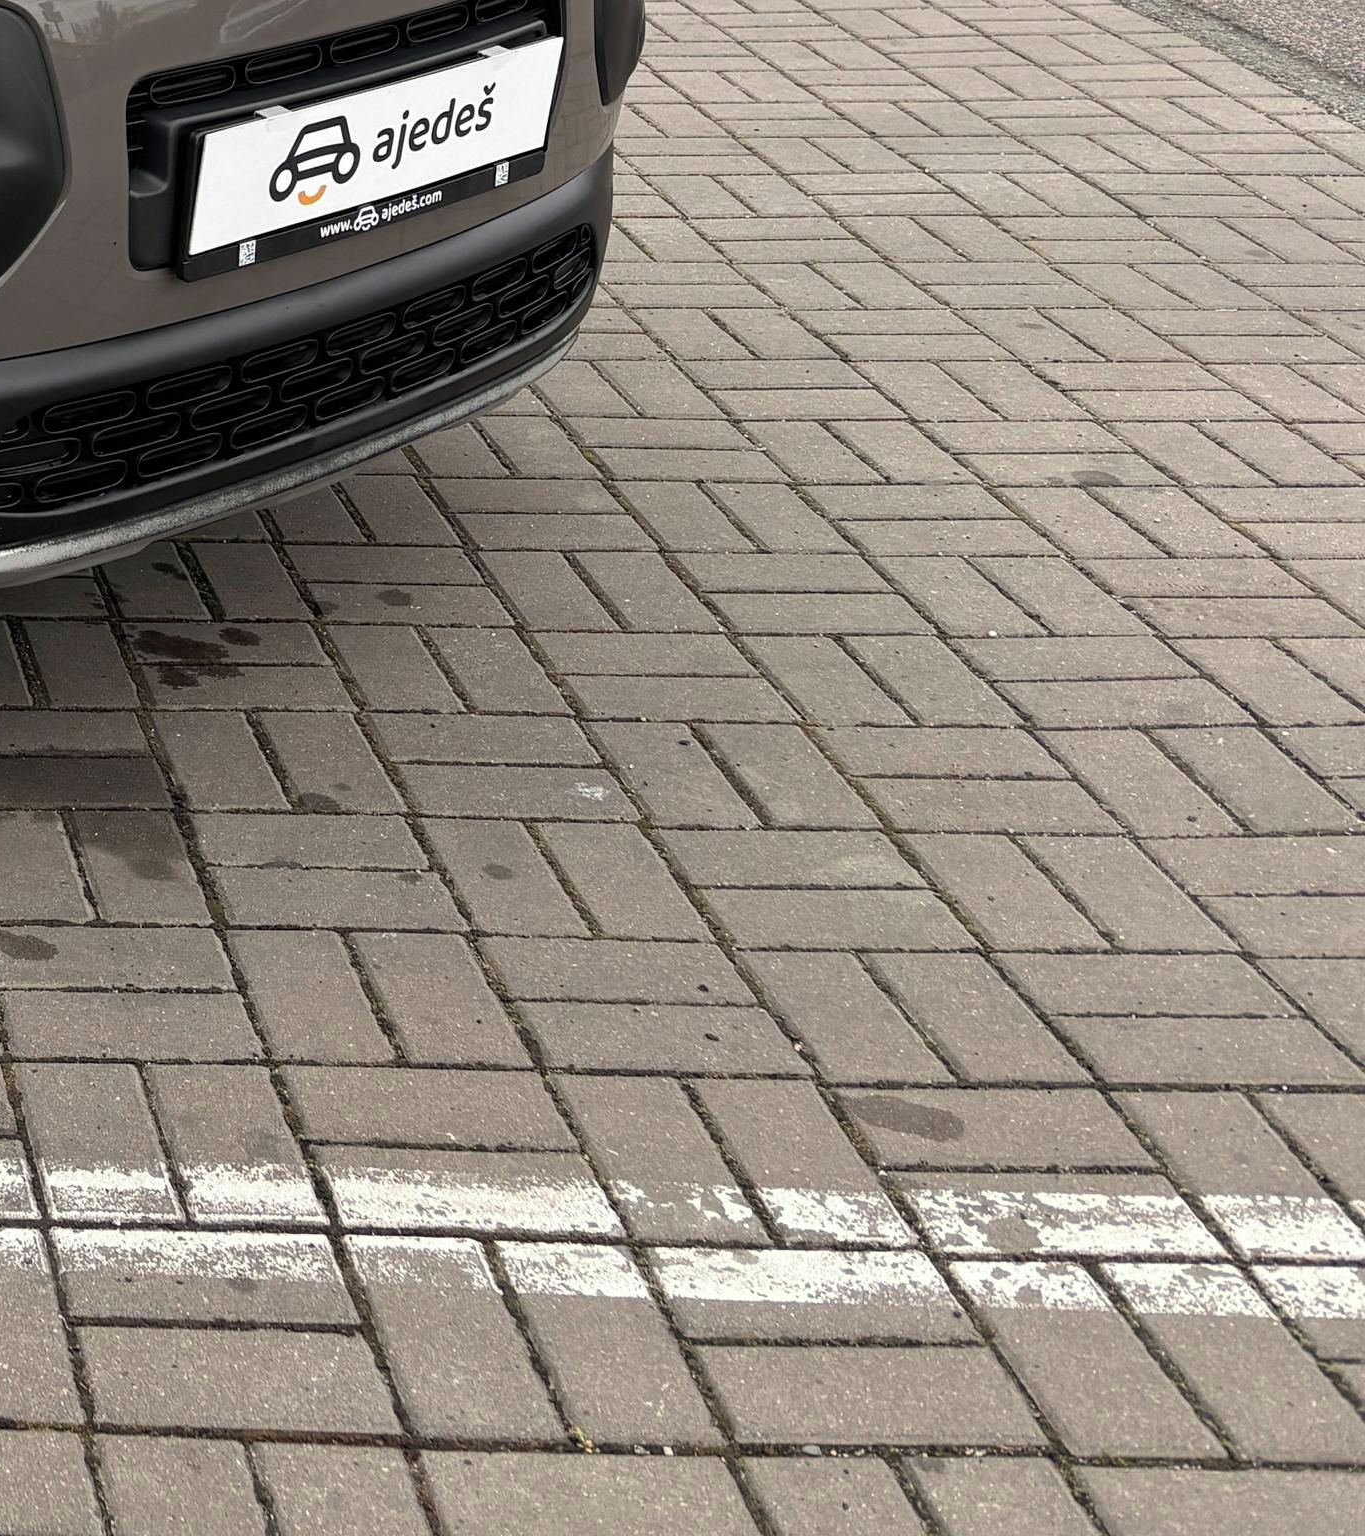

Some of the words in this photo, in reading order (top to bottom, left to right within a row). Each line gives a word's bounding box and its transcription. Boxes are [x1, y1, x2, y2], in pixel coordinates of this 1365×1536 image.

[372, 82, 496, 170] ajedeš
[320, 219, 353, 238] www.
[381, 190, 443, 221] ajedeš.com
